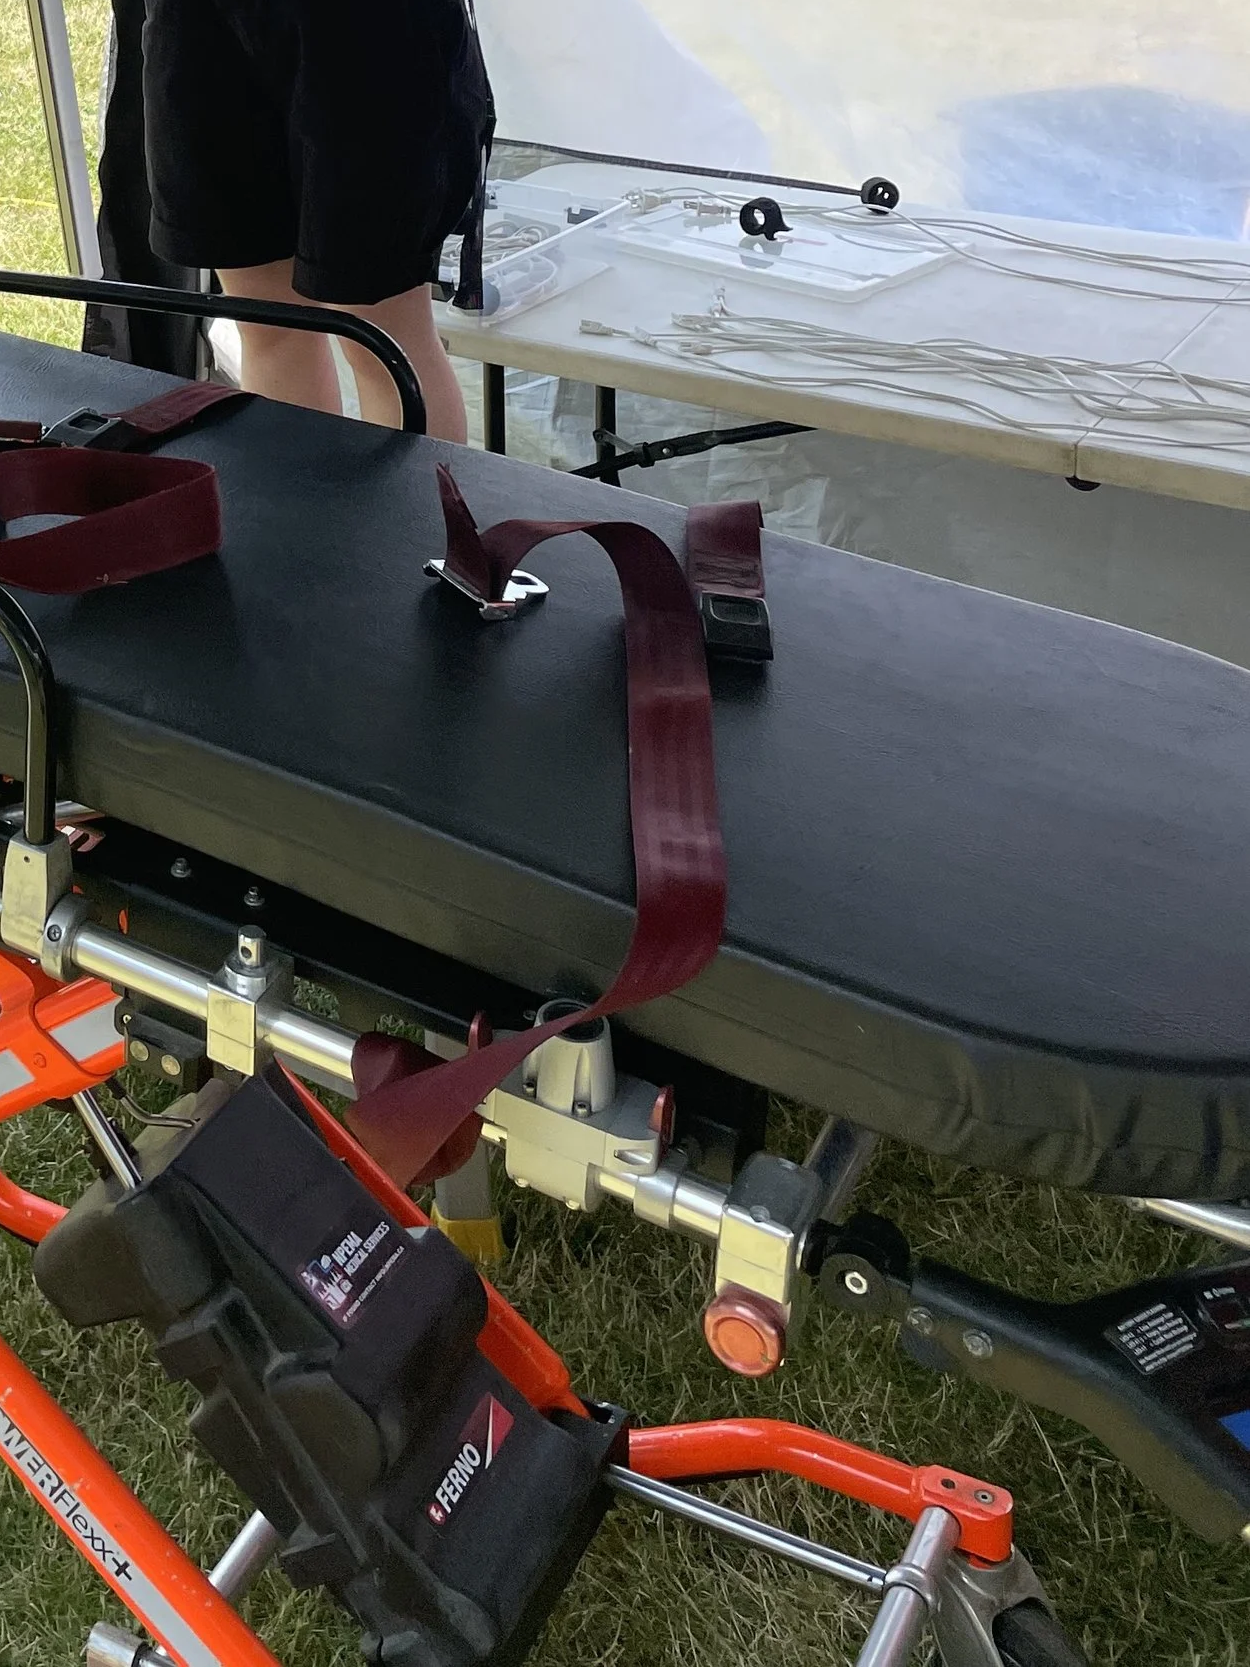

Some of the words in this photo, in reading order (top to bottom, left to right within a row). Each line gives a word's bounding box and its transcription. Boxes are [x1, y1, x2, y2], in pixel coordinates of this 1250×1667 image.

[331, 1231, 363, 1266] NPEMA
[343, 1247, 369, 1277] MEDICAL
[362, 1221, 390, 1253] SERVICES
[359, 1279, 377, 1301] CONTACT
[438, 1442, 482, 1514] FERNO
